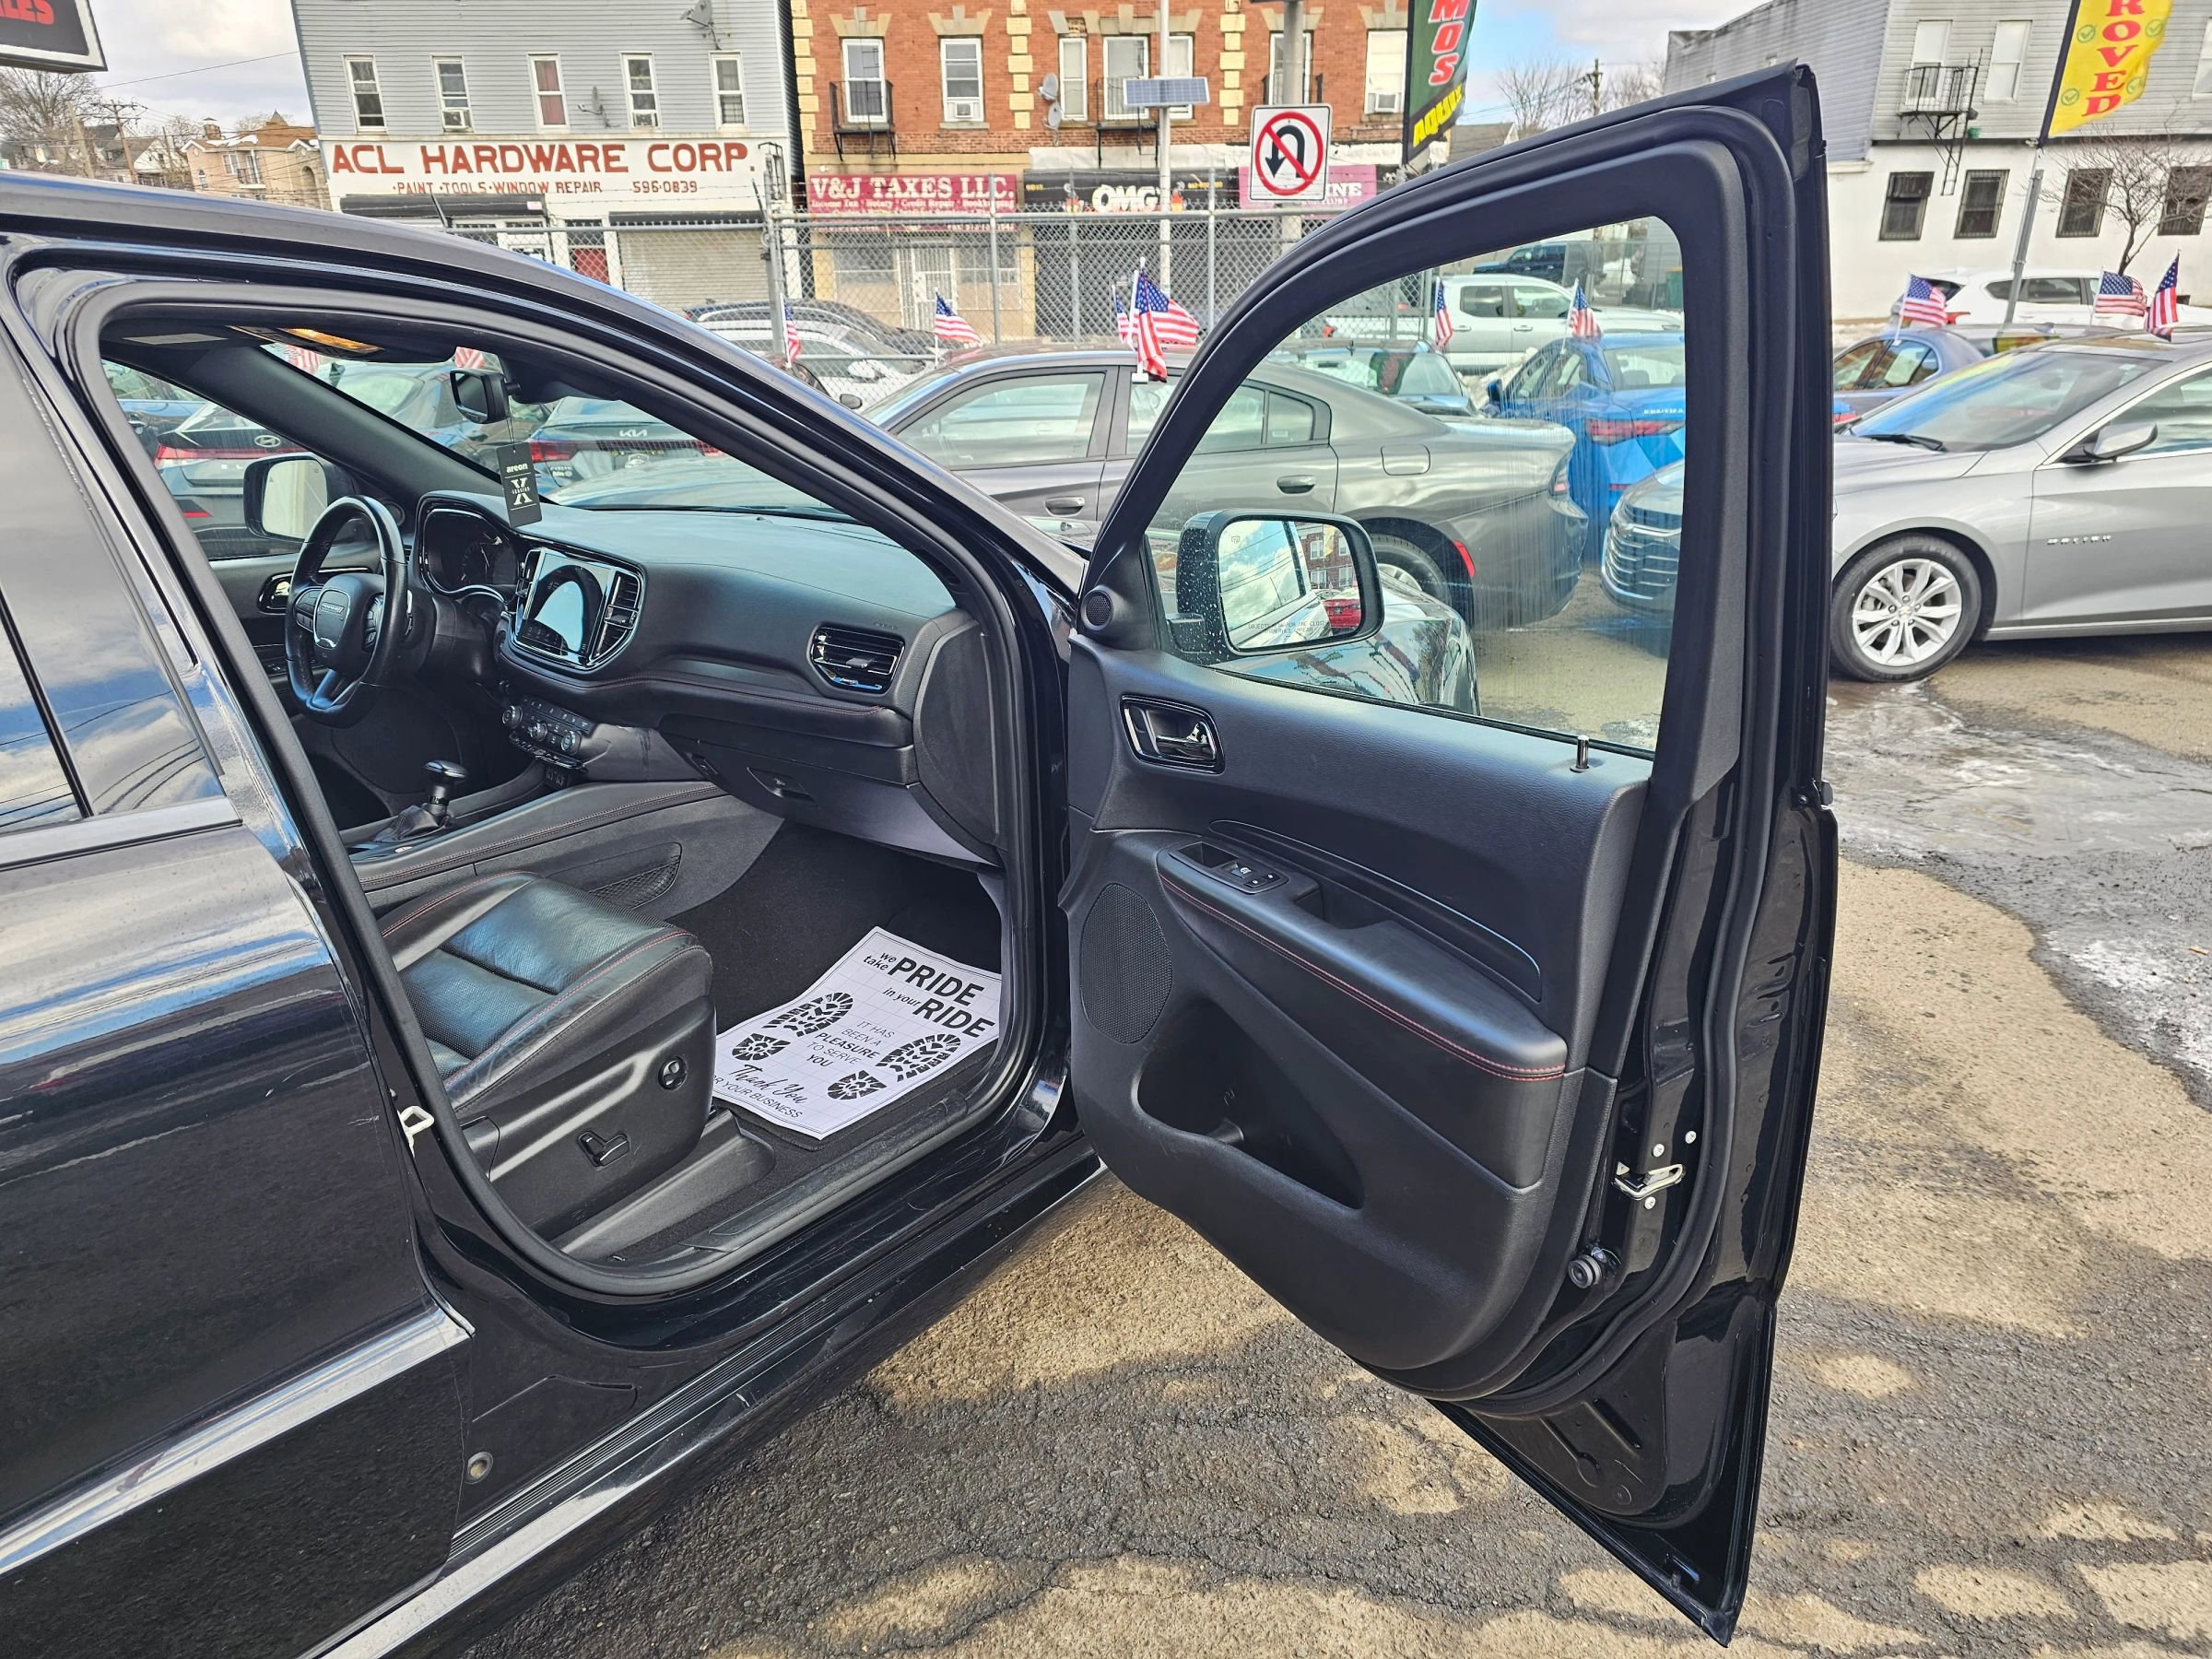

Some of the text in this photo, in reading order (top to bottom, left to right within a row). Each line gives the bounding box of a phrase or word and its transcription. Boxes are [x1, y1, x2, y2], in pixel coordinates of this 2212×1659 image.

[333, 142, 755, 174] ACL HARDWARE CORP.
[556, 181, 603, 194] REPAIR
[811, 176, 1015, 199] V&J TAXES LLC.
[506, 463, 528, 474] areon
[879, 952, 897, 963] we
[863, 955, 985, 1006] take PRIDE
[882, 987, 996, 1039] in your RIDE
[841, 1028, 873, 1042] BEEN
[857, 1020, 895, 1039] IT HAS
[807, 1041, 862, 1065] TO SERVE
[814, 1032, 881, 1059] PLEASURE
[806, 1053, 834, 1067] YOU
[729, 1064, 808, 1104] Thank You
[723, 1081, 753, 1096] YOUR
[749, 1092, 804, 1118] BUSINESS
